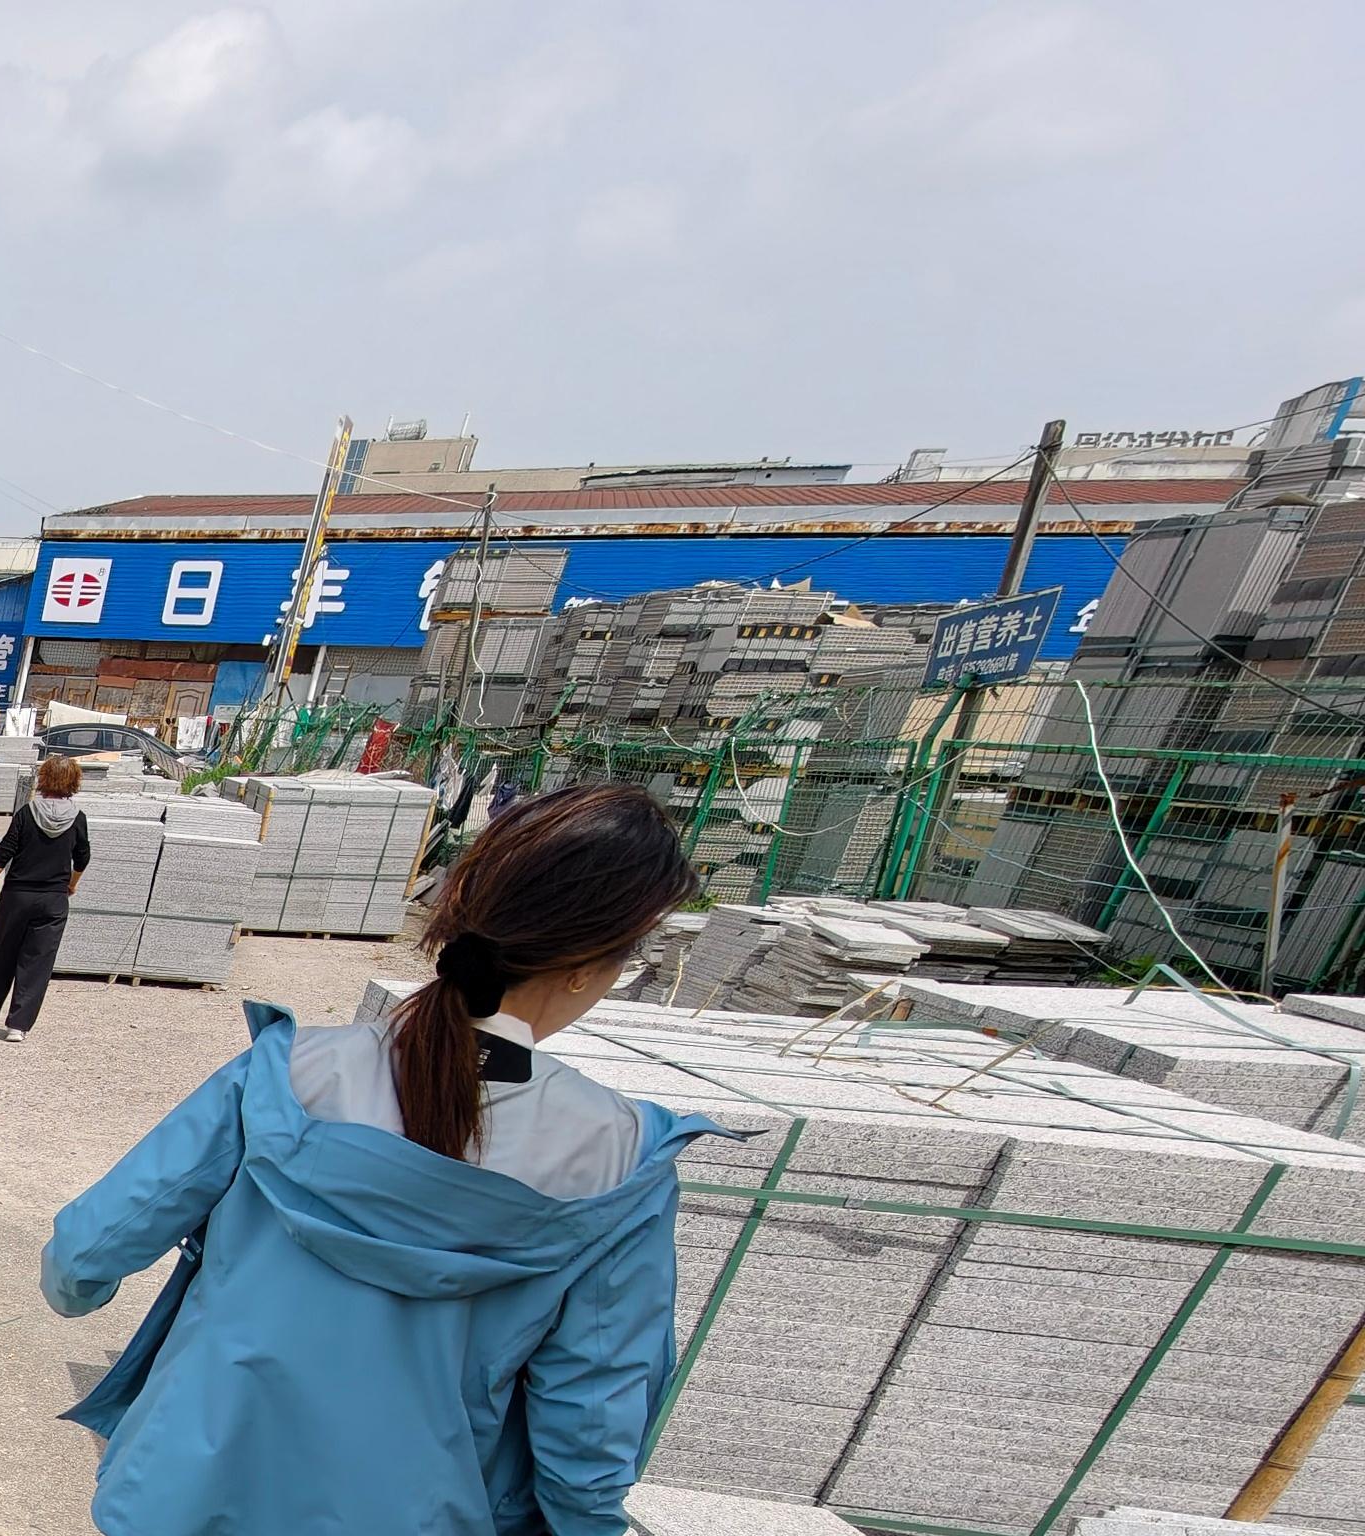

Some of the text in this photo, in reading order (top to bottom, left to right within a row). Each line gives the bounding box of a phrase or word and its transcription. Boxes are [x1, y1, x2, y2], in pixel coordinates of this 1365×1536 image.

[937, 606, 1042, 659] 出售营养土
